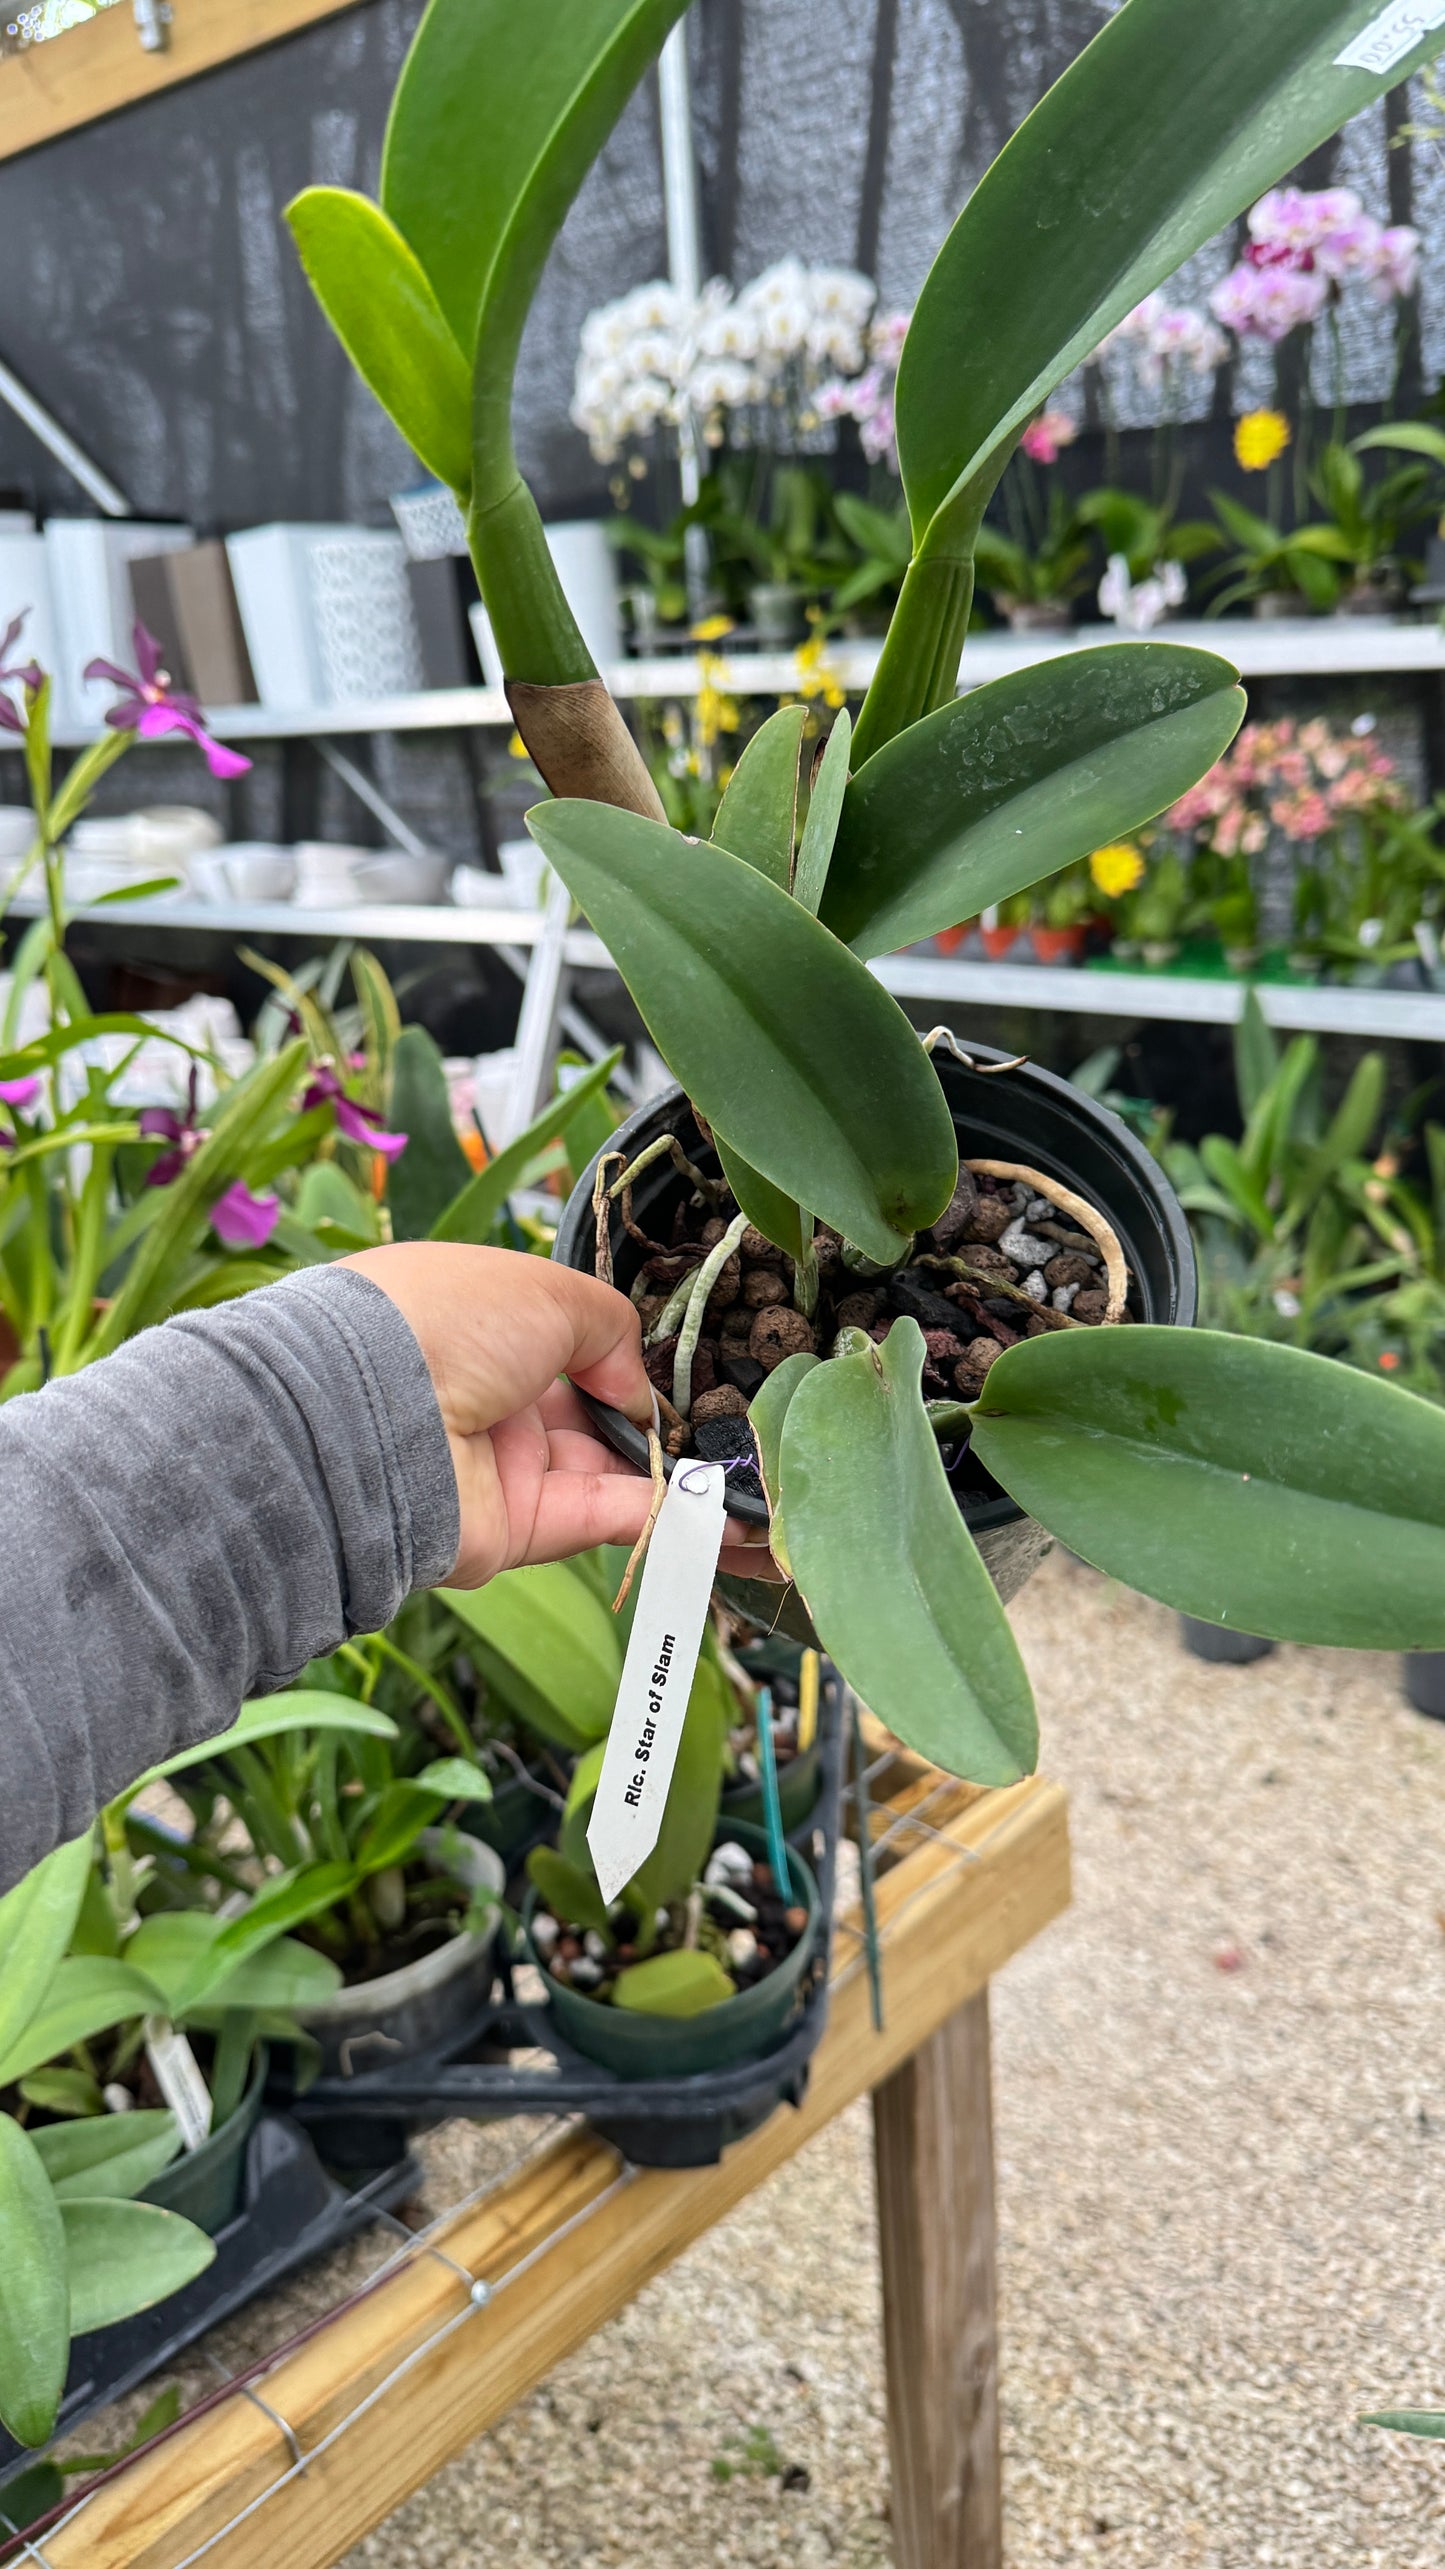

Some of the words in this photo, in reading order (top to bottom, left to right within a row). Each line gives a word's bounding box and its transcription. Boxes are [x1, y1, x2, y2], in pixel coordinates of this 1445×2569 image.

[624, 1769, 646, 1807] Rlc.
[635, 1717, 657, 1762] Star
[648, 1689, 663, 1714] of
